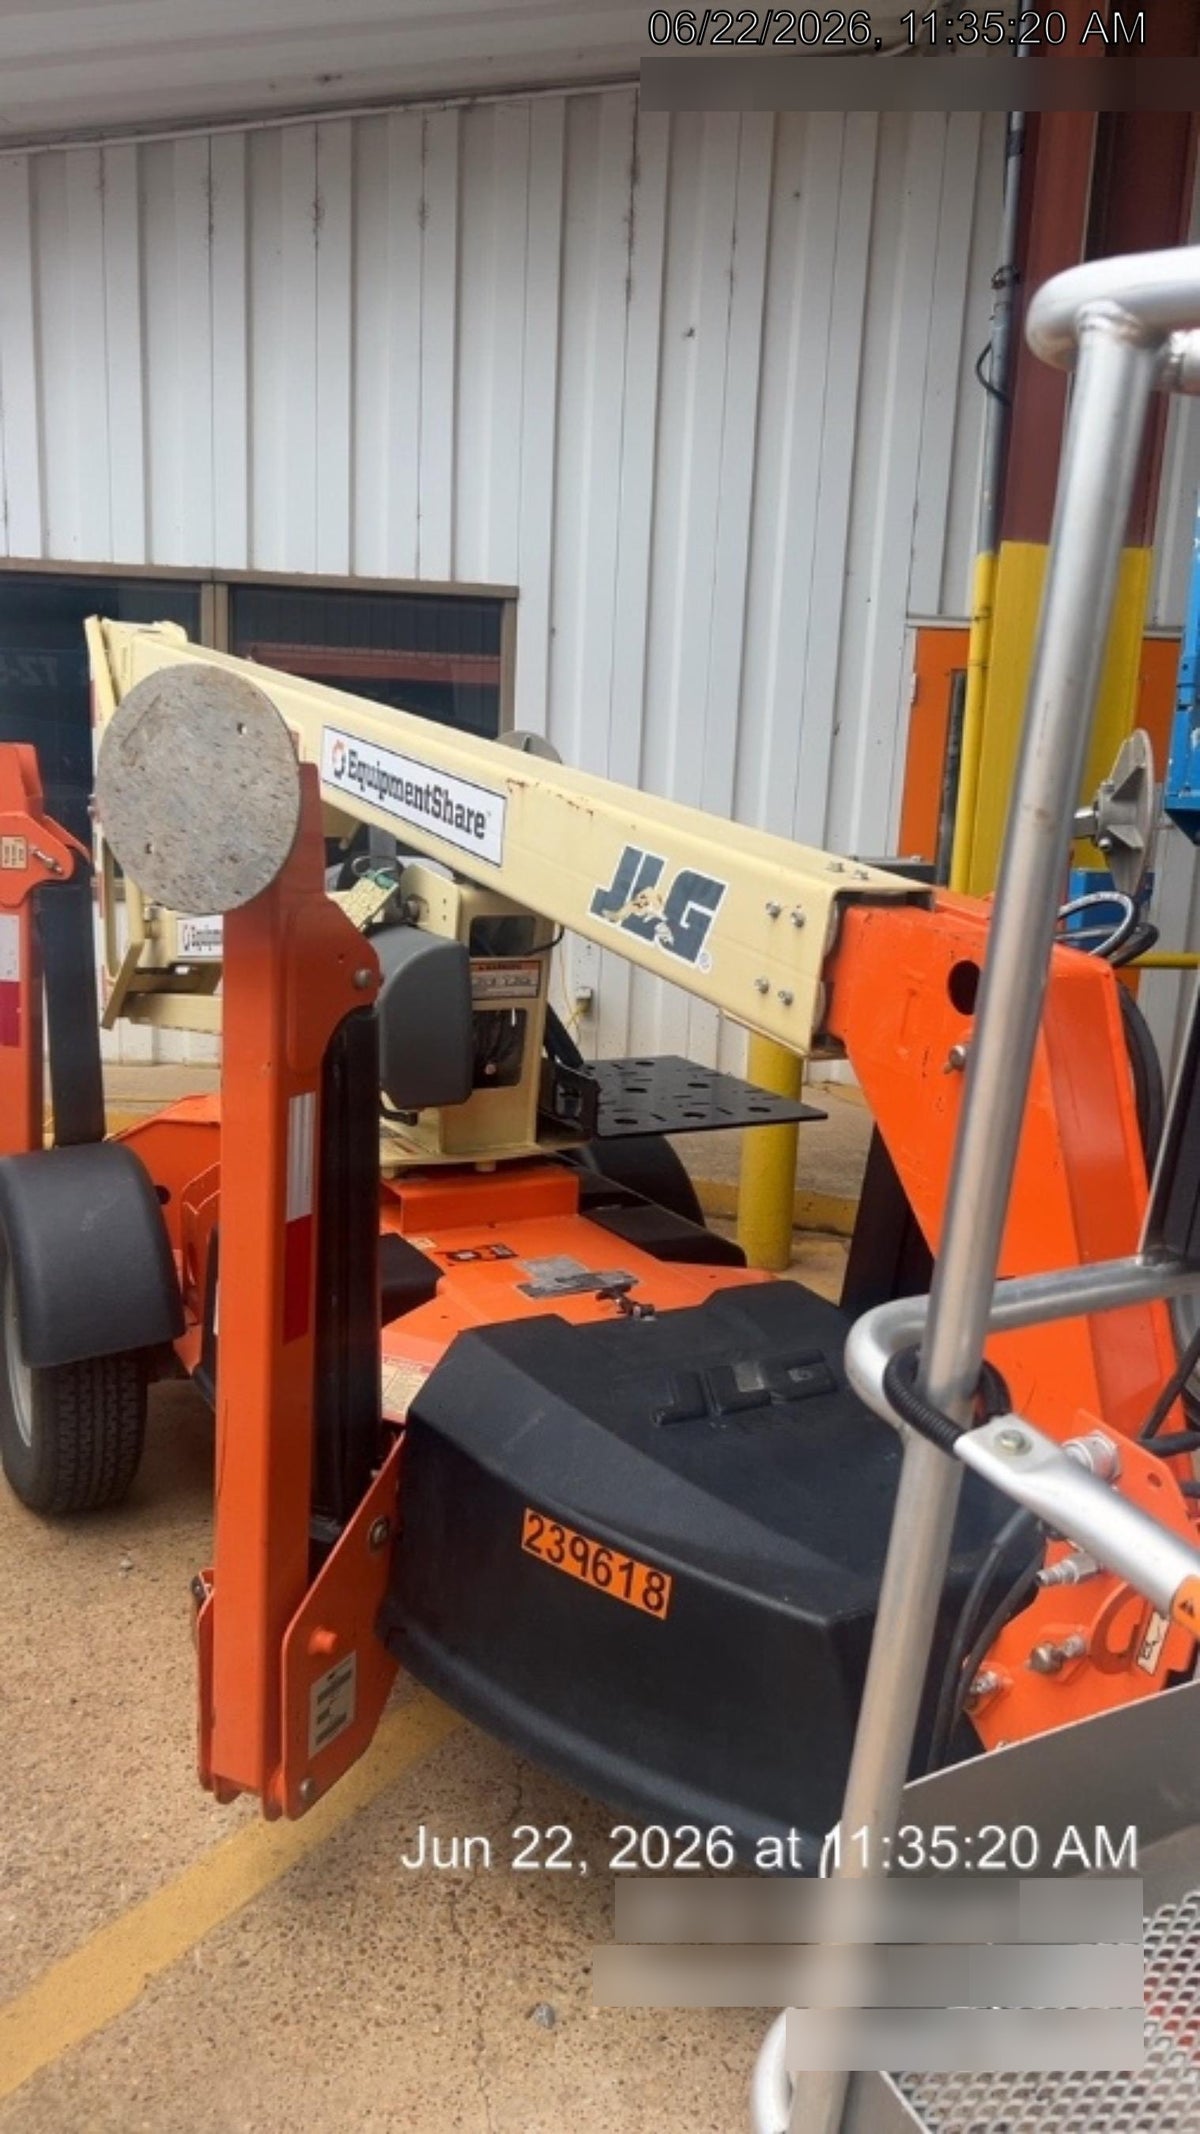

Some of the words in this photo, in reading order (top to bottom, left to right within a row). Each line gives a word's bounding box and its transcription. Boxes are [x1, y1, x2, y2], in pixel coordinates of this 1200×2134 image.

[348, 749, 486, 839] EquipmentShare
[589, 844, 727, 965] JLG
[524, 1514, 667, 1613] 239618
